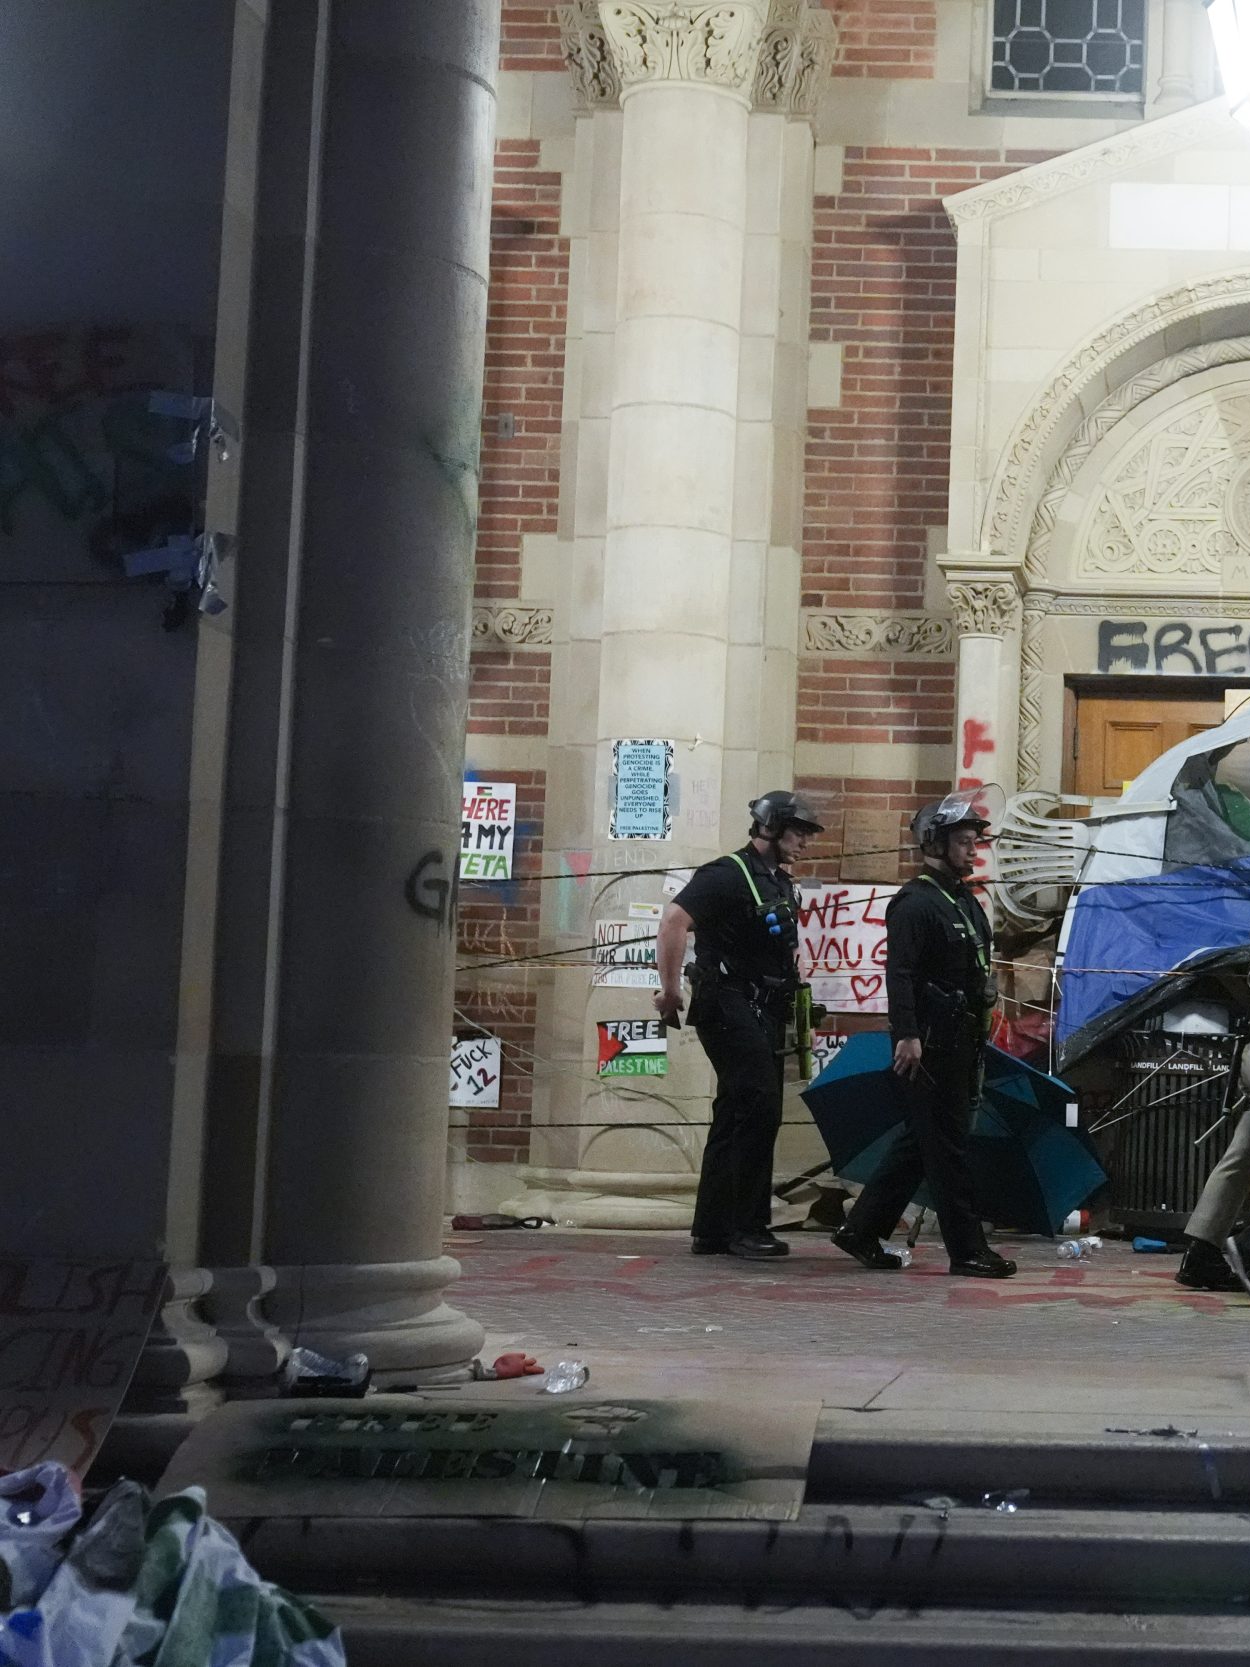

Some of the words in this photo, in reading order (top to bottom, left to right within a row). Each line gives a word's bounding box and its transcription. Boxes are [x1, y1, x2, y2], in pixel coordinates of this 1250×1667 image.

[476, 824, 512, 850] MY
[798, 890, 855, 929] WE
[862, 887, 886, 926] L
[598, 923, 628, 946] NOT
[625, 948, 656, 969] NAM
[805, 935, 863, 977] YOU
[871, 937, 887, 967] G
[648, 973, 660, 985] PAL
[606, 1020, 660, 1041] FREE
[450, 1040, 492, 1079] FUCK
[600, 1058, 667, 1074] PALESTINE
[1168, 1063, 1204, 1071] LANDFILL
[467, 1067, 497, 1096] 12
